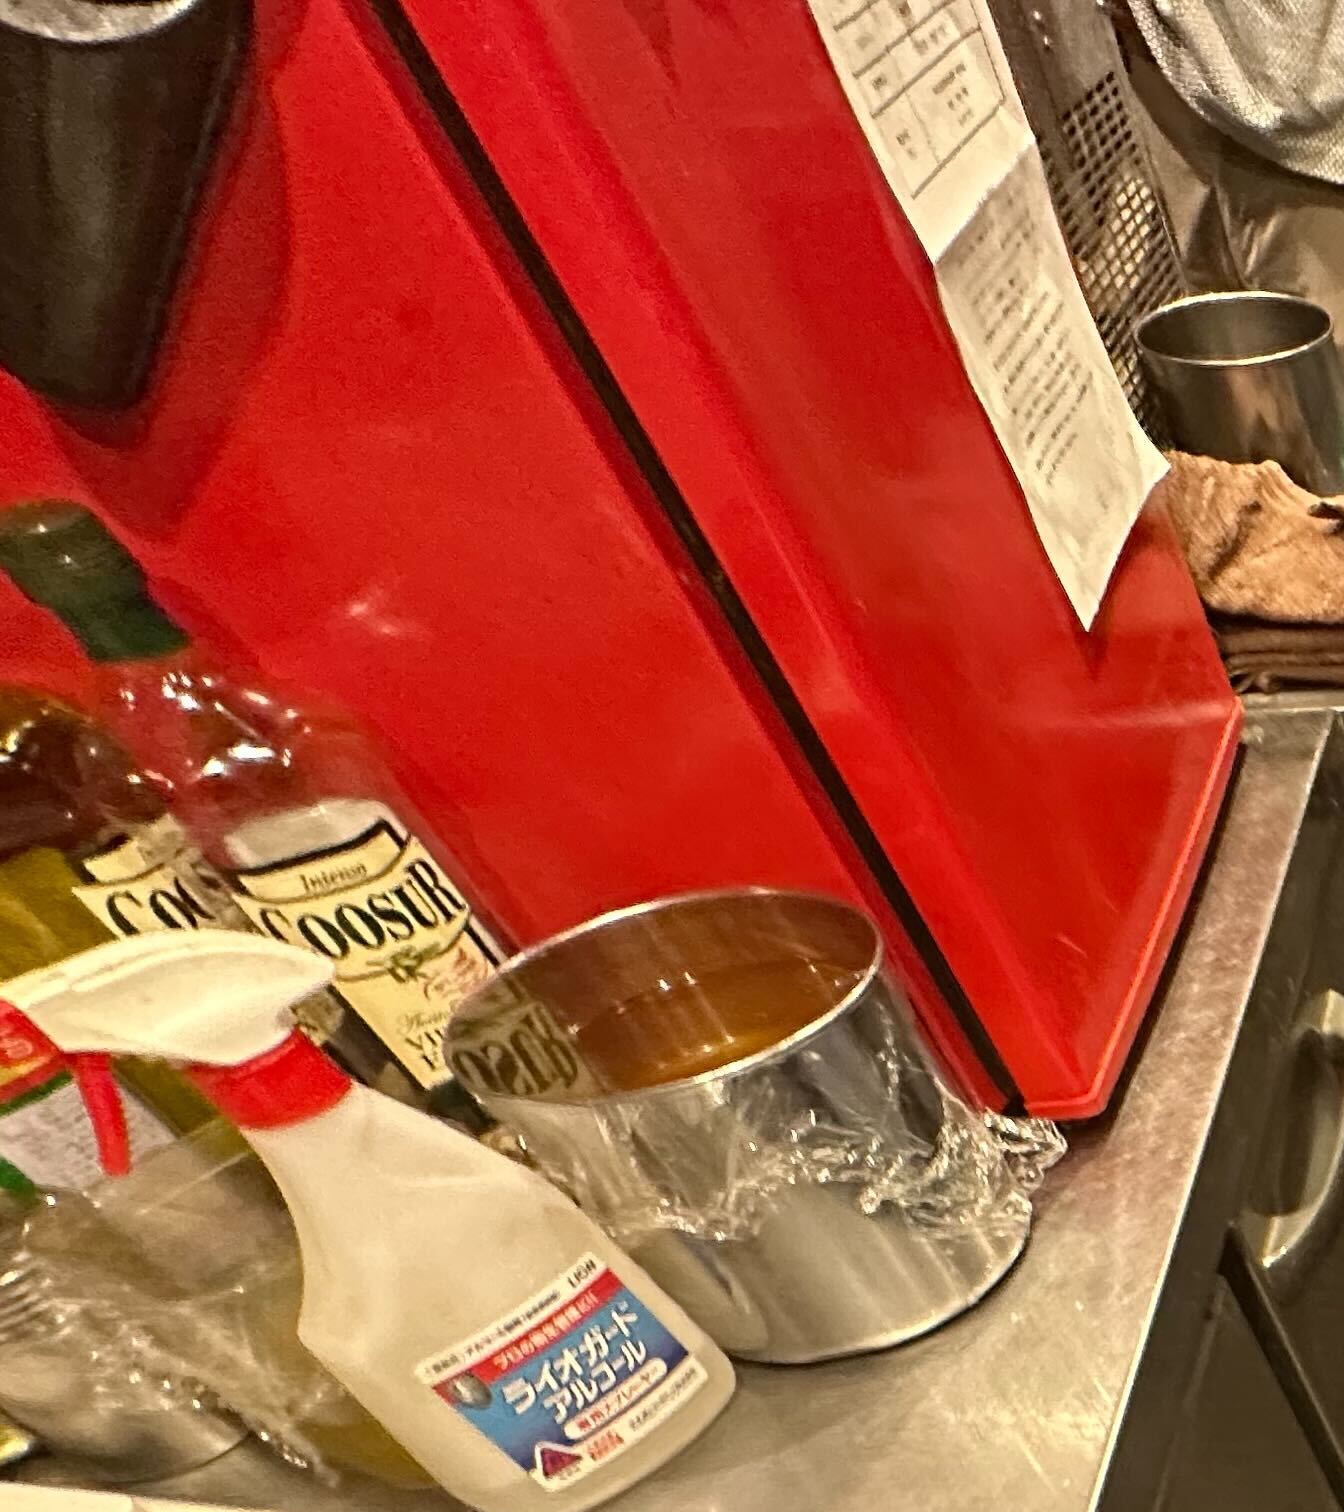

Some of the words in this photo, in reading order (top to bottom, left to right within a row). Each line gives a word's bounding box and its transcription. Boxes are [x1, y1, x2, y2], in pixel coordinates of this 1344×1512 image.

[259, 858, 466, 960] COOSUR
[567, 1258, 598, 1289] LION
[501, 1300, 639, 1416] ライオガード
[543, 1339, 648, 1424] アルコール
